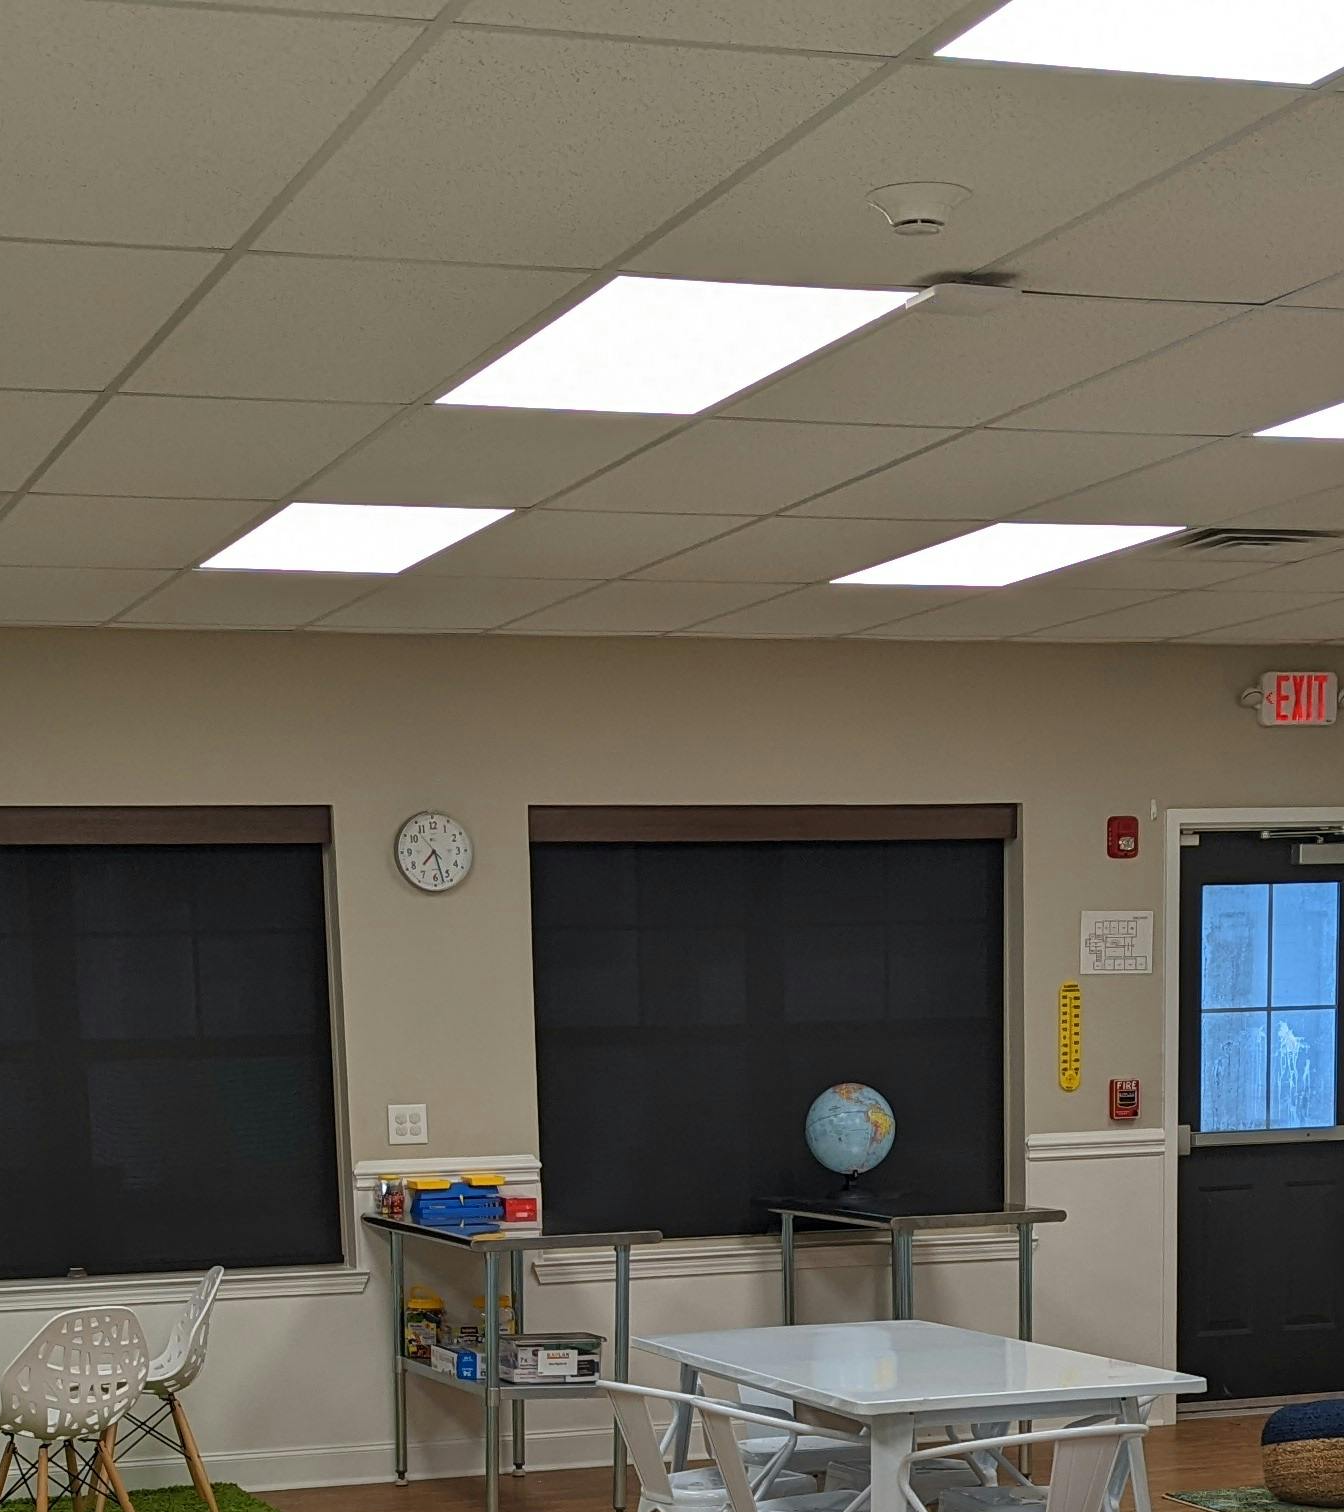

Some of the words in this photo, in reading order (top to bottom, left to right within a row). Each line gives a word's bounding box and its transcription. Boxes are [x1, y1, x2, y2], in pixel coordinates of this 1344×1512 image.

[1275, 674, 1329, 721] EXIT
[429, 822, 437, 830] 12
[410, 834, 418, 843] 10
[1116, 1080, 1137, 1090] FIRE
